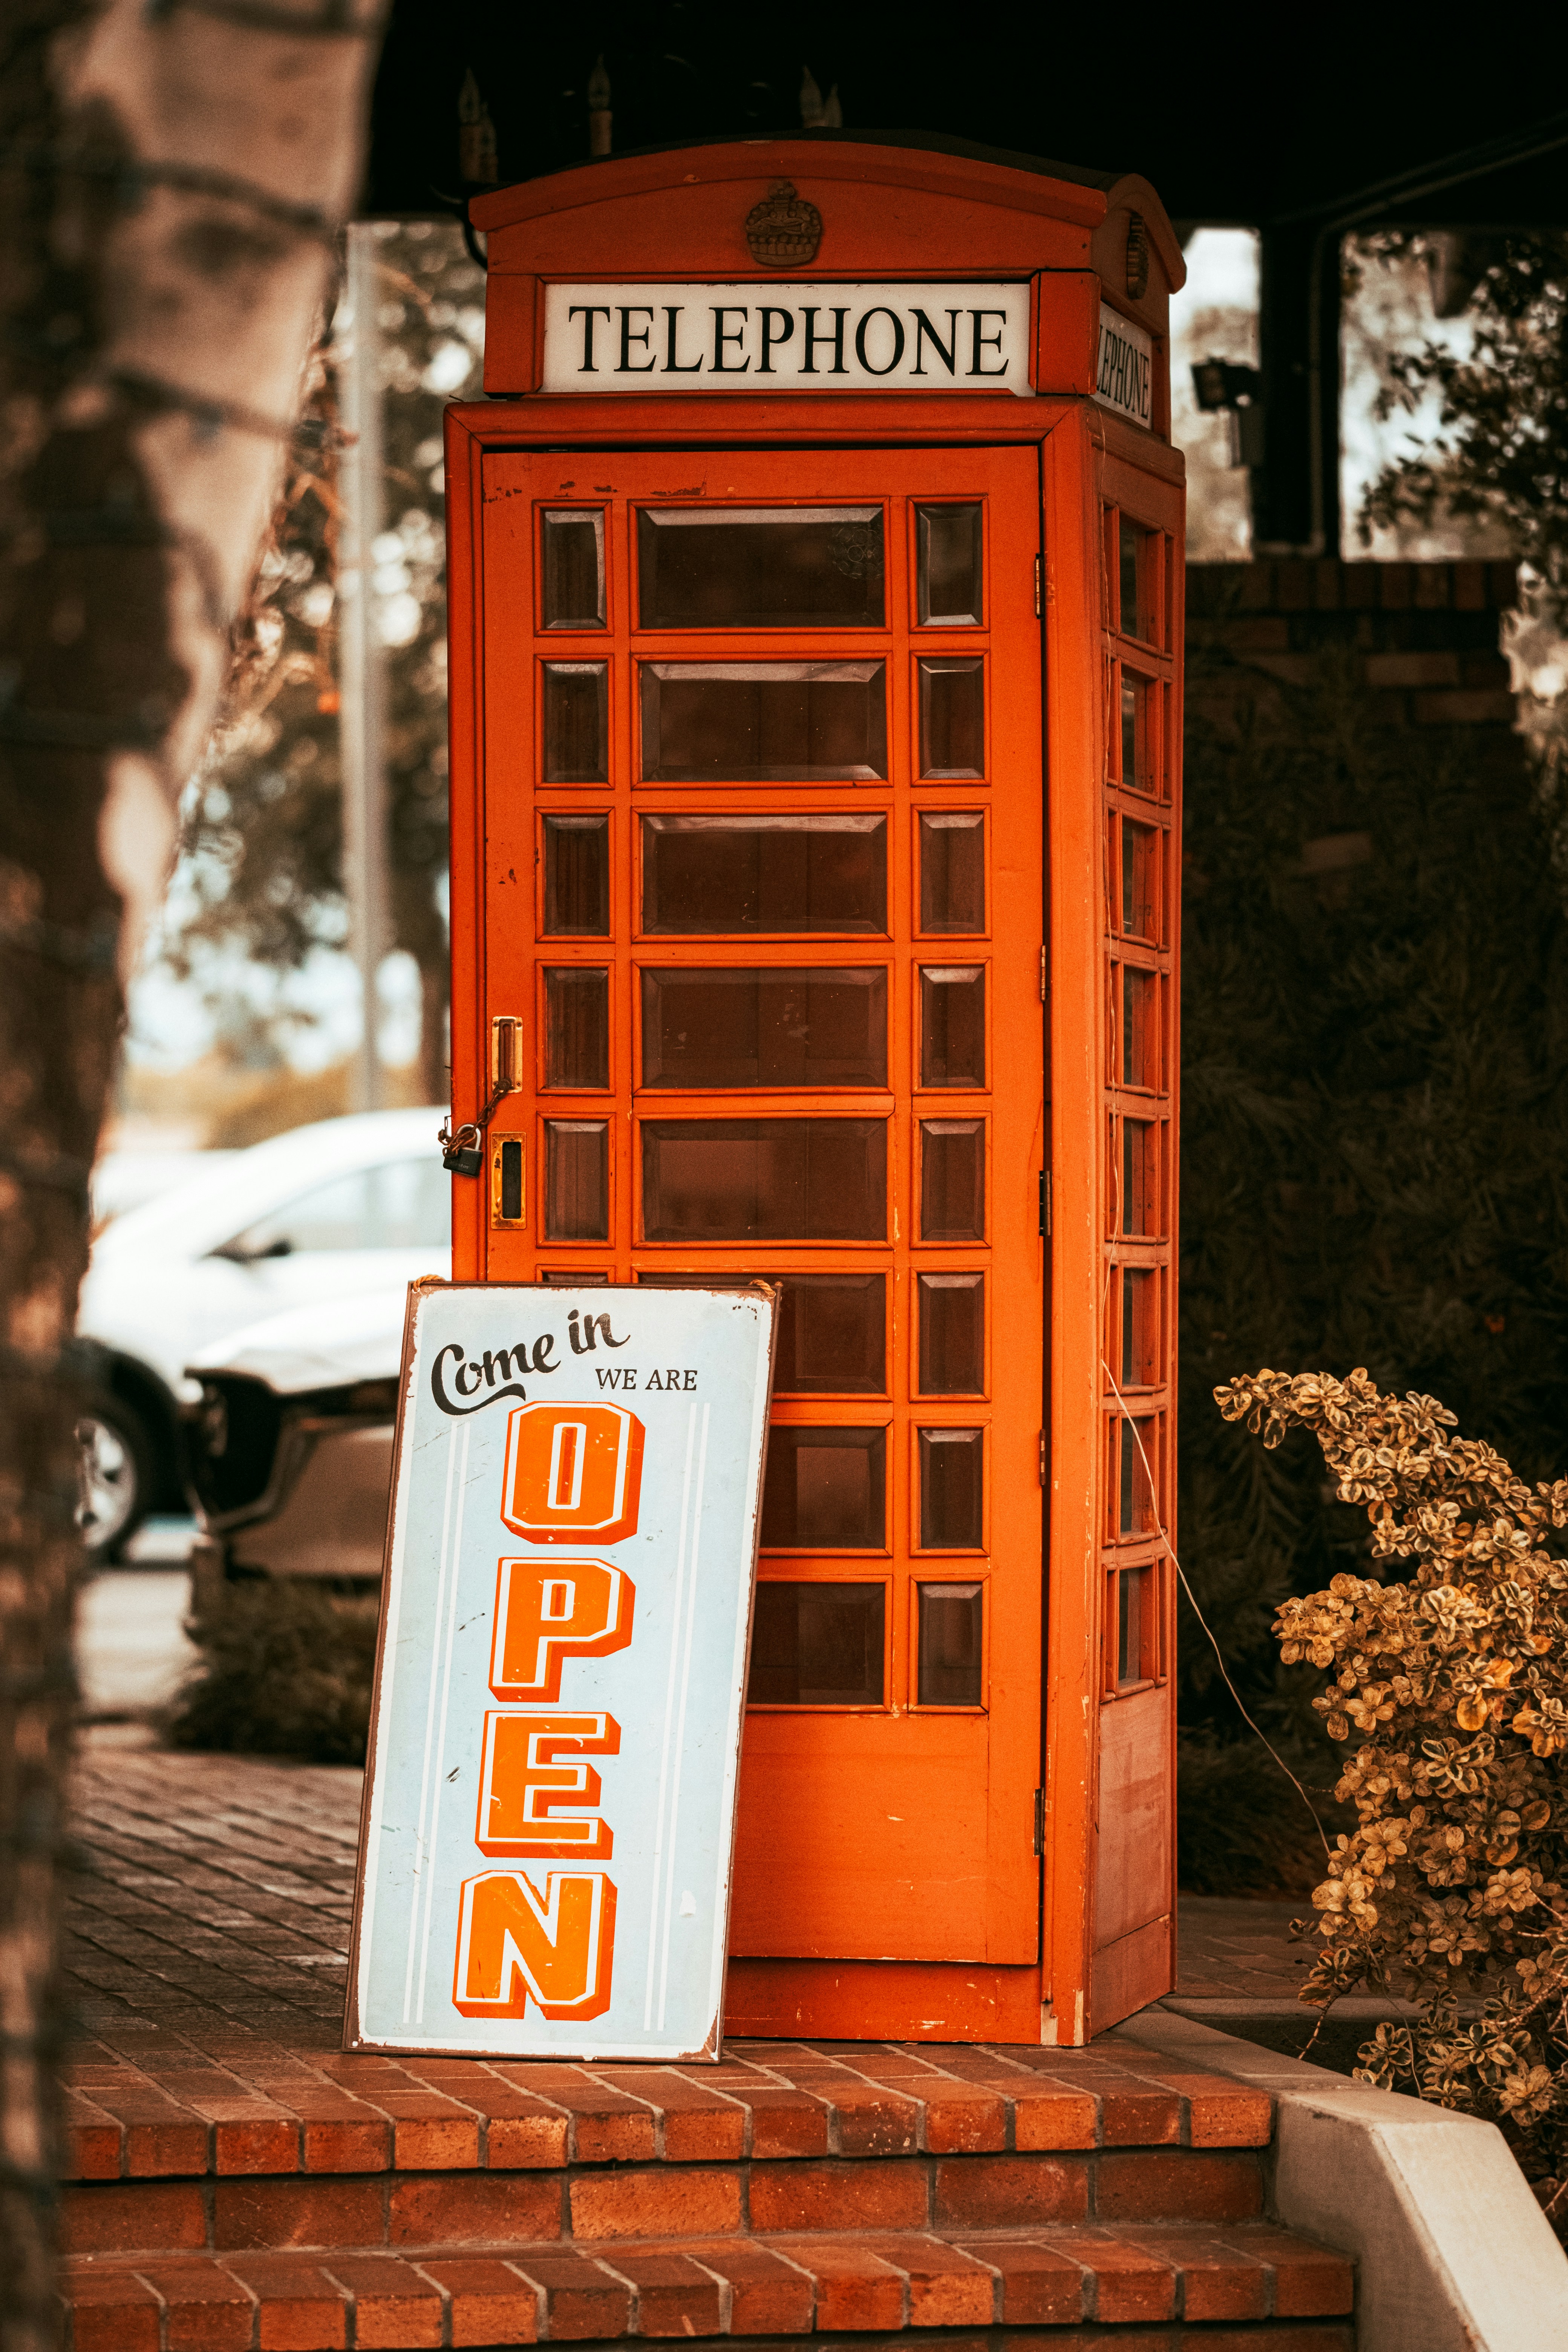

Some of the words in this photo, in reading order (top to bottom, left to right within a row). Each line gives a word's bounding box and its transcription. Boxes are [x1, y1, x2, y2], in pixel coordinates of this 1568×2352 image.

[568, 306, 1009, 376] TELEPHONE
[431, 1334, 561, 1416] Come
[568, 1309, 631, 1355] in
[595, 1368, 637, 1390] WE
[645, 1369, 698, 1391] ARE
[452, 1401, 646, 2021] OPEN
